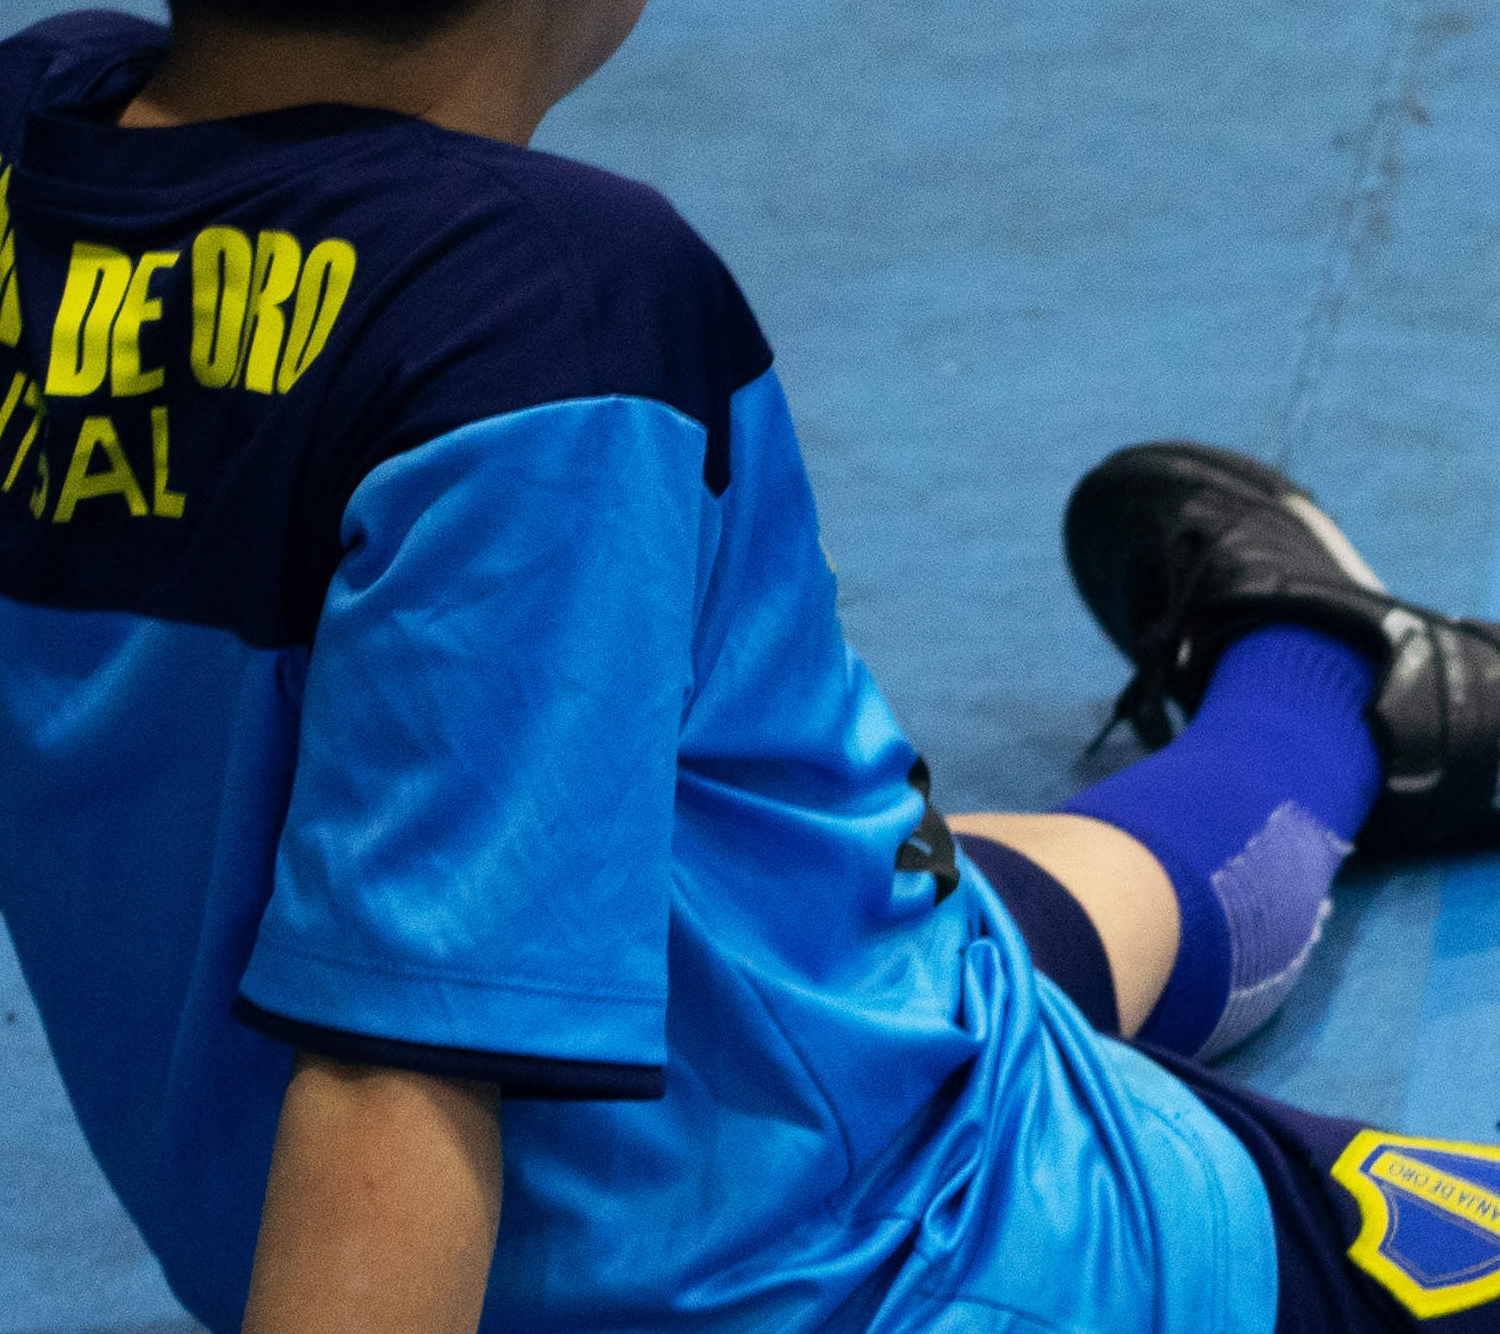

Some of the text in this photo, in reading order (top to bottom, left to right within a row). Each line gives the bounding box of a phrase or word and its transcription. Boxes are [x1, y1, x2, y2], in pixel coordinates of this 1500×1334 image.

[44, 241, 180, 398] DE
[190, 224, 357, 395] ORO
[1433, 1178, 1454, 1200] DE
